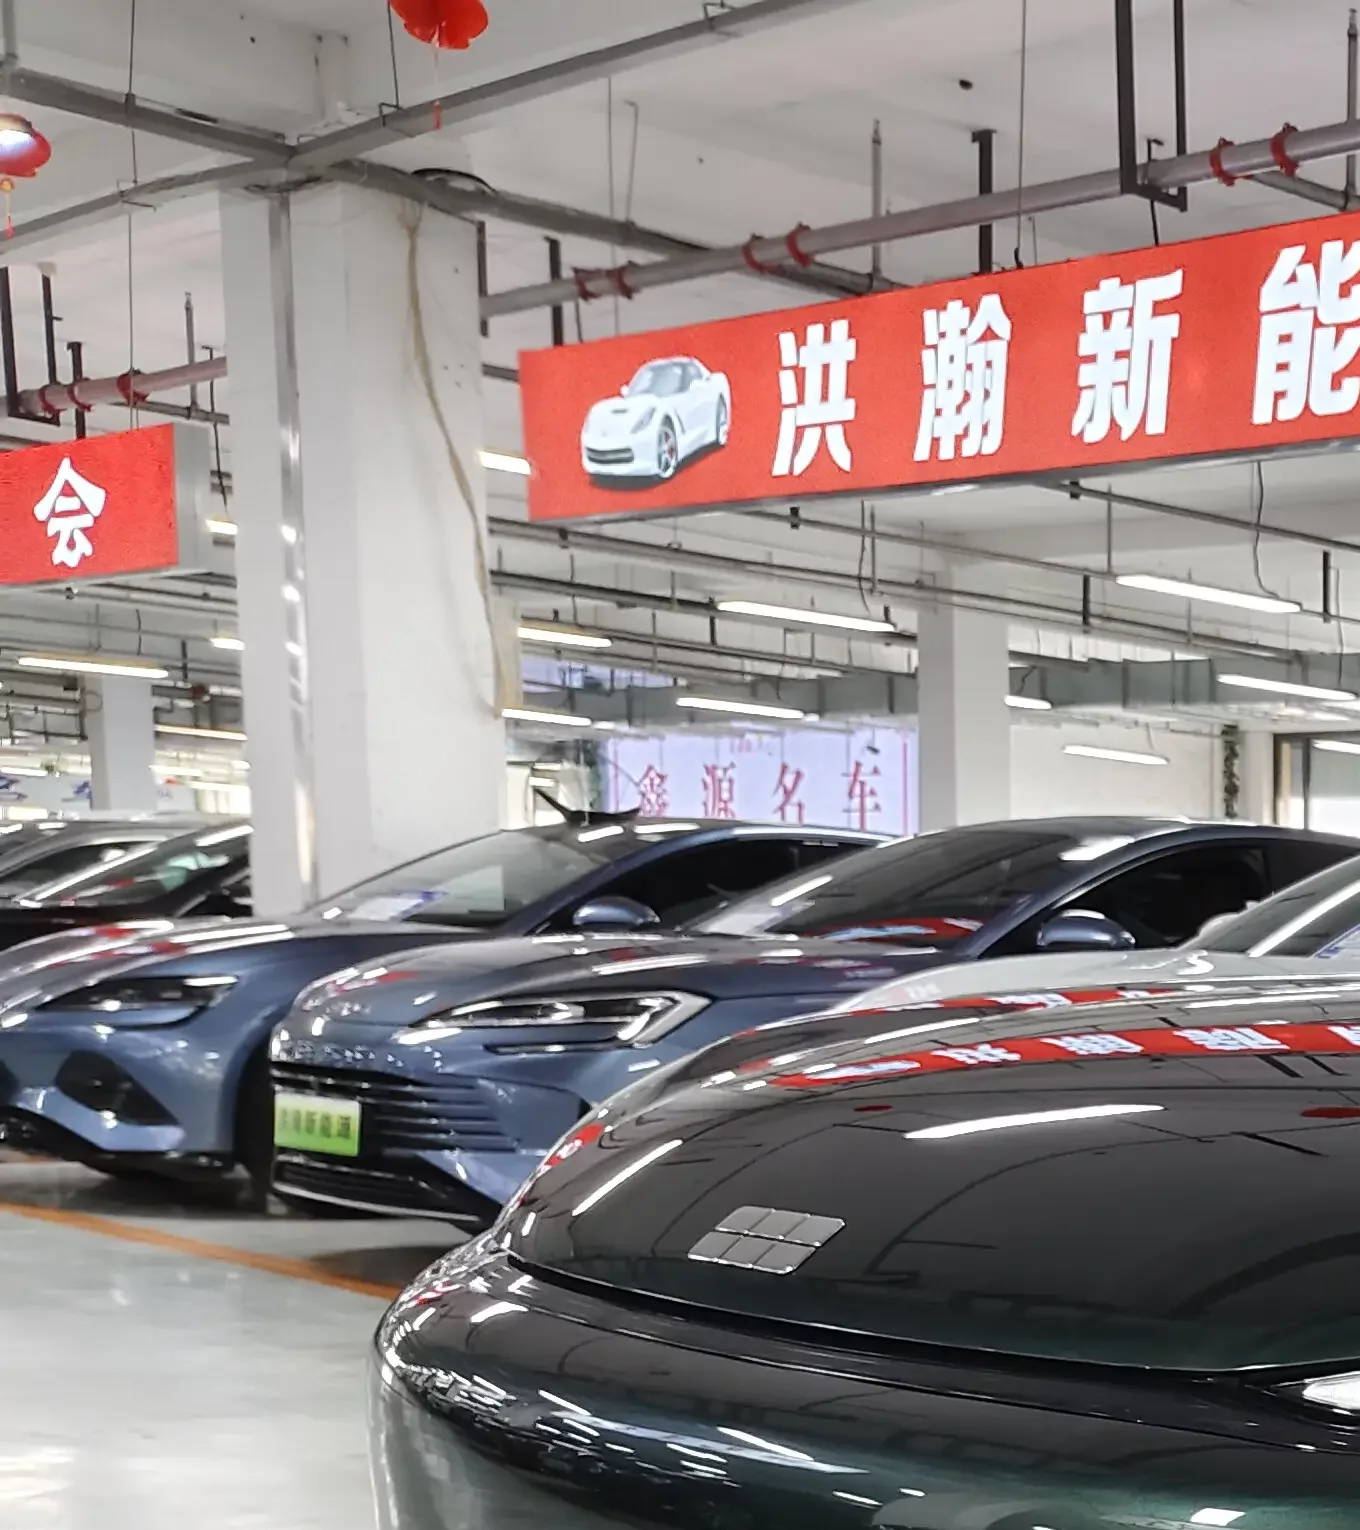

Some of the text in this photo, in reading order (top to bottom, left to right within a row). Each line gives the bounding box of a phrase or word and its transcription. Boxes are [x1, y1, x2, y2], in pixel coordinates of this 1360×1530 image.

[33, 457, 107, 569] 会
[639, 761, 882, 831] 鑫源名车
